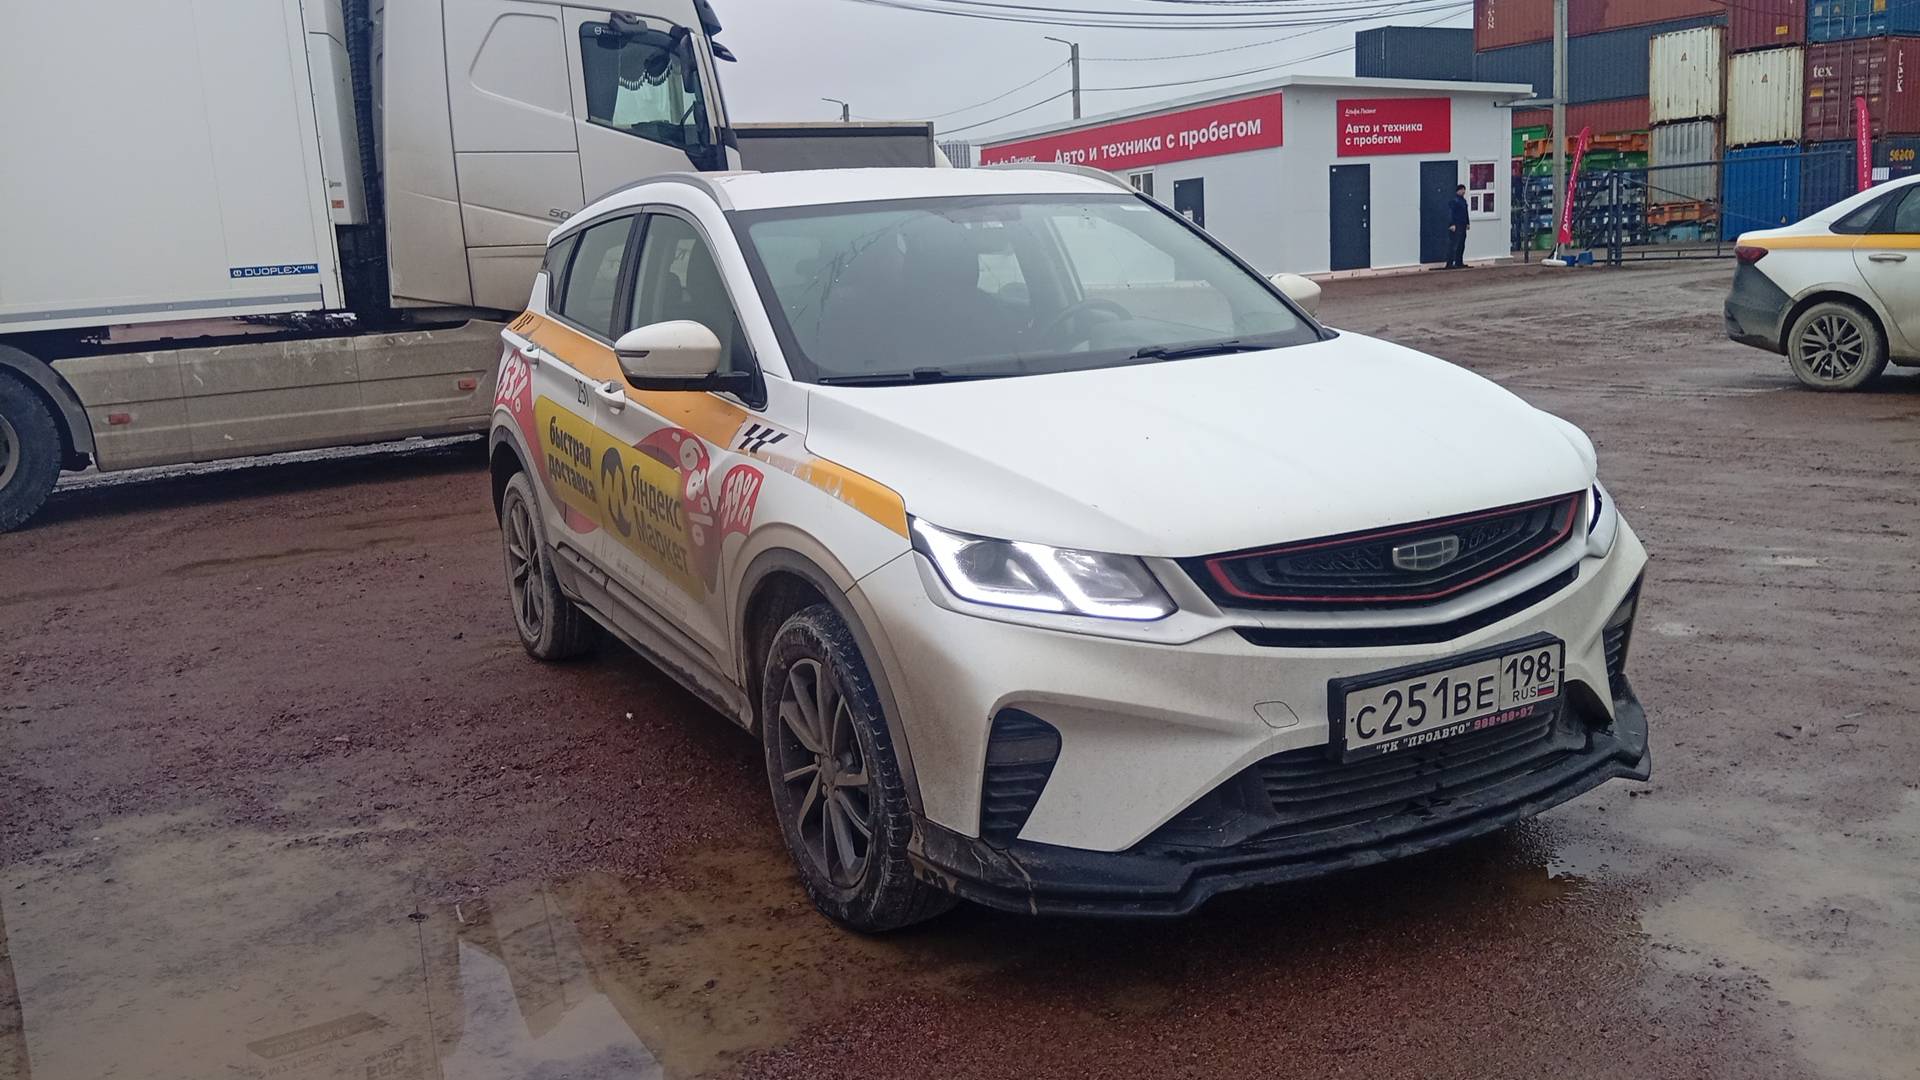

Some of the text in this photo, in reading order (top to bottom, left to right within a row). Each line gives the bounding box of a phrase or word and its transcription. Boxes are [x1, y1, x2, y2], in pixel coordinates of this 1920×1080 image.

[1813, 65, 1833, 78] tex
[1054, 118, 1262, 164] Авто и техника с пробегом
[1345, 123, 1423, 134] Авто и техника
[1345, 134, 1401, 147] с пробегом
[244, 265, 300, 277] DUOPLEX
[550, 416, 592, 470] быстрая
[548, 453, 597, 504] доставка
[631, 465, 682, 532] Яндекс
[633, 505, 689, 575] Маркет
[1504, 650, 1551, 690] 198
[1512, 686, 1537, 702] RUS
